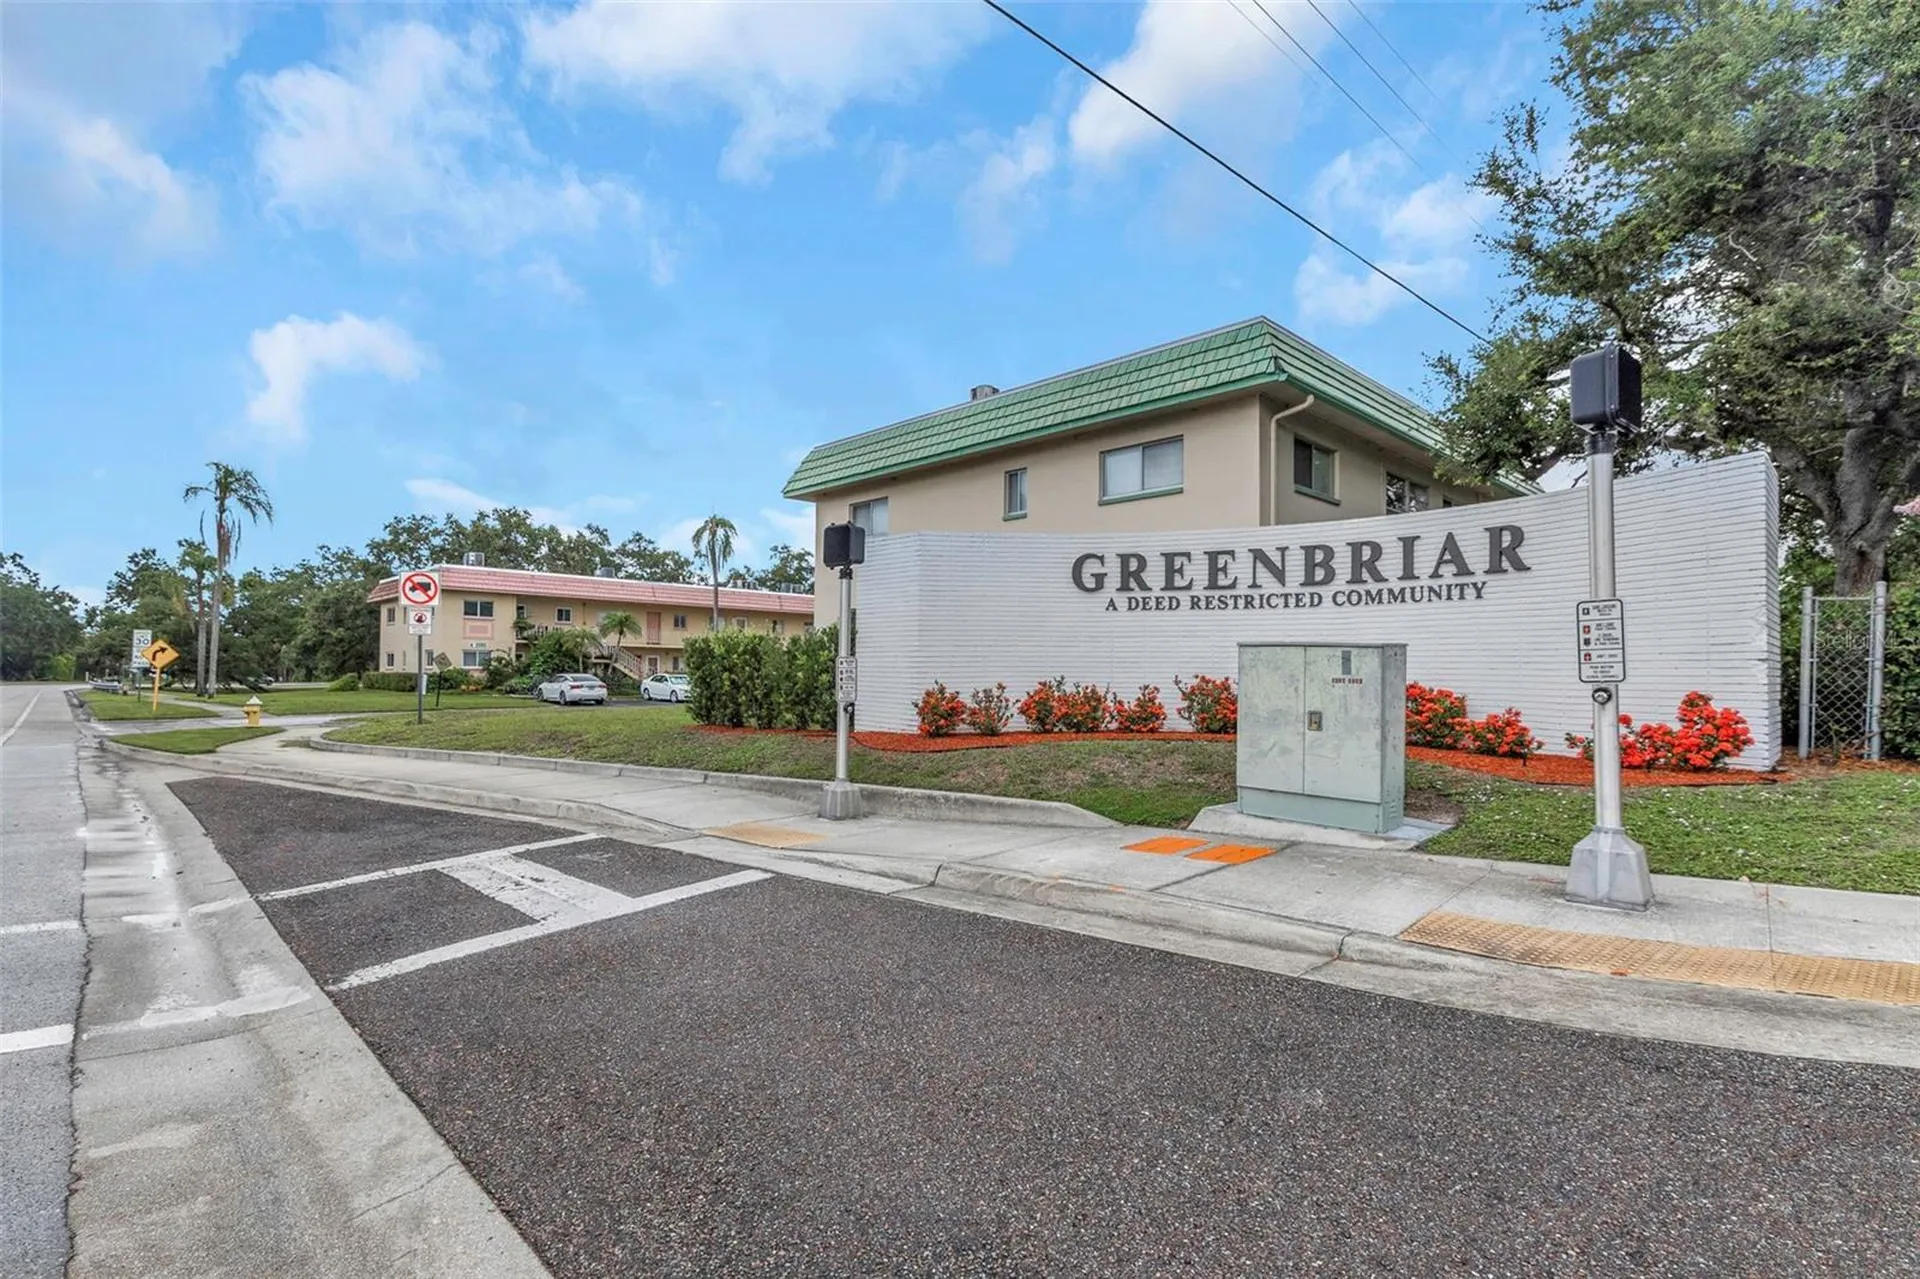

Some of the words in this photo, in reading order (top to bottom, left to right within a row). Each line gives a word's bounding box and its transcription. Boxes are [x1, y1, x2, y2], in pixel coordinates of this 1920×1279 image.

[1071, 524, 1531, 593] GREENBRIAR
[1106, 595, 1120, 612] A
[1127, 594, 1181, 611] DEED
[1189, 591, 1324, 611] RESTRICTED
[1331, 580, 1488, 607] COMMUNITY
